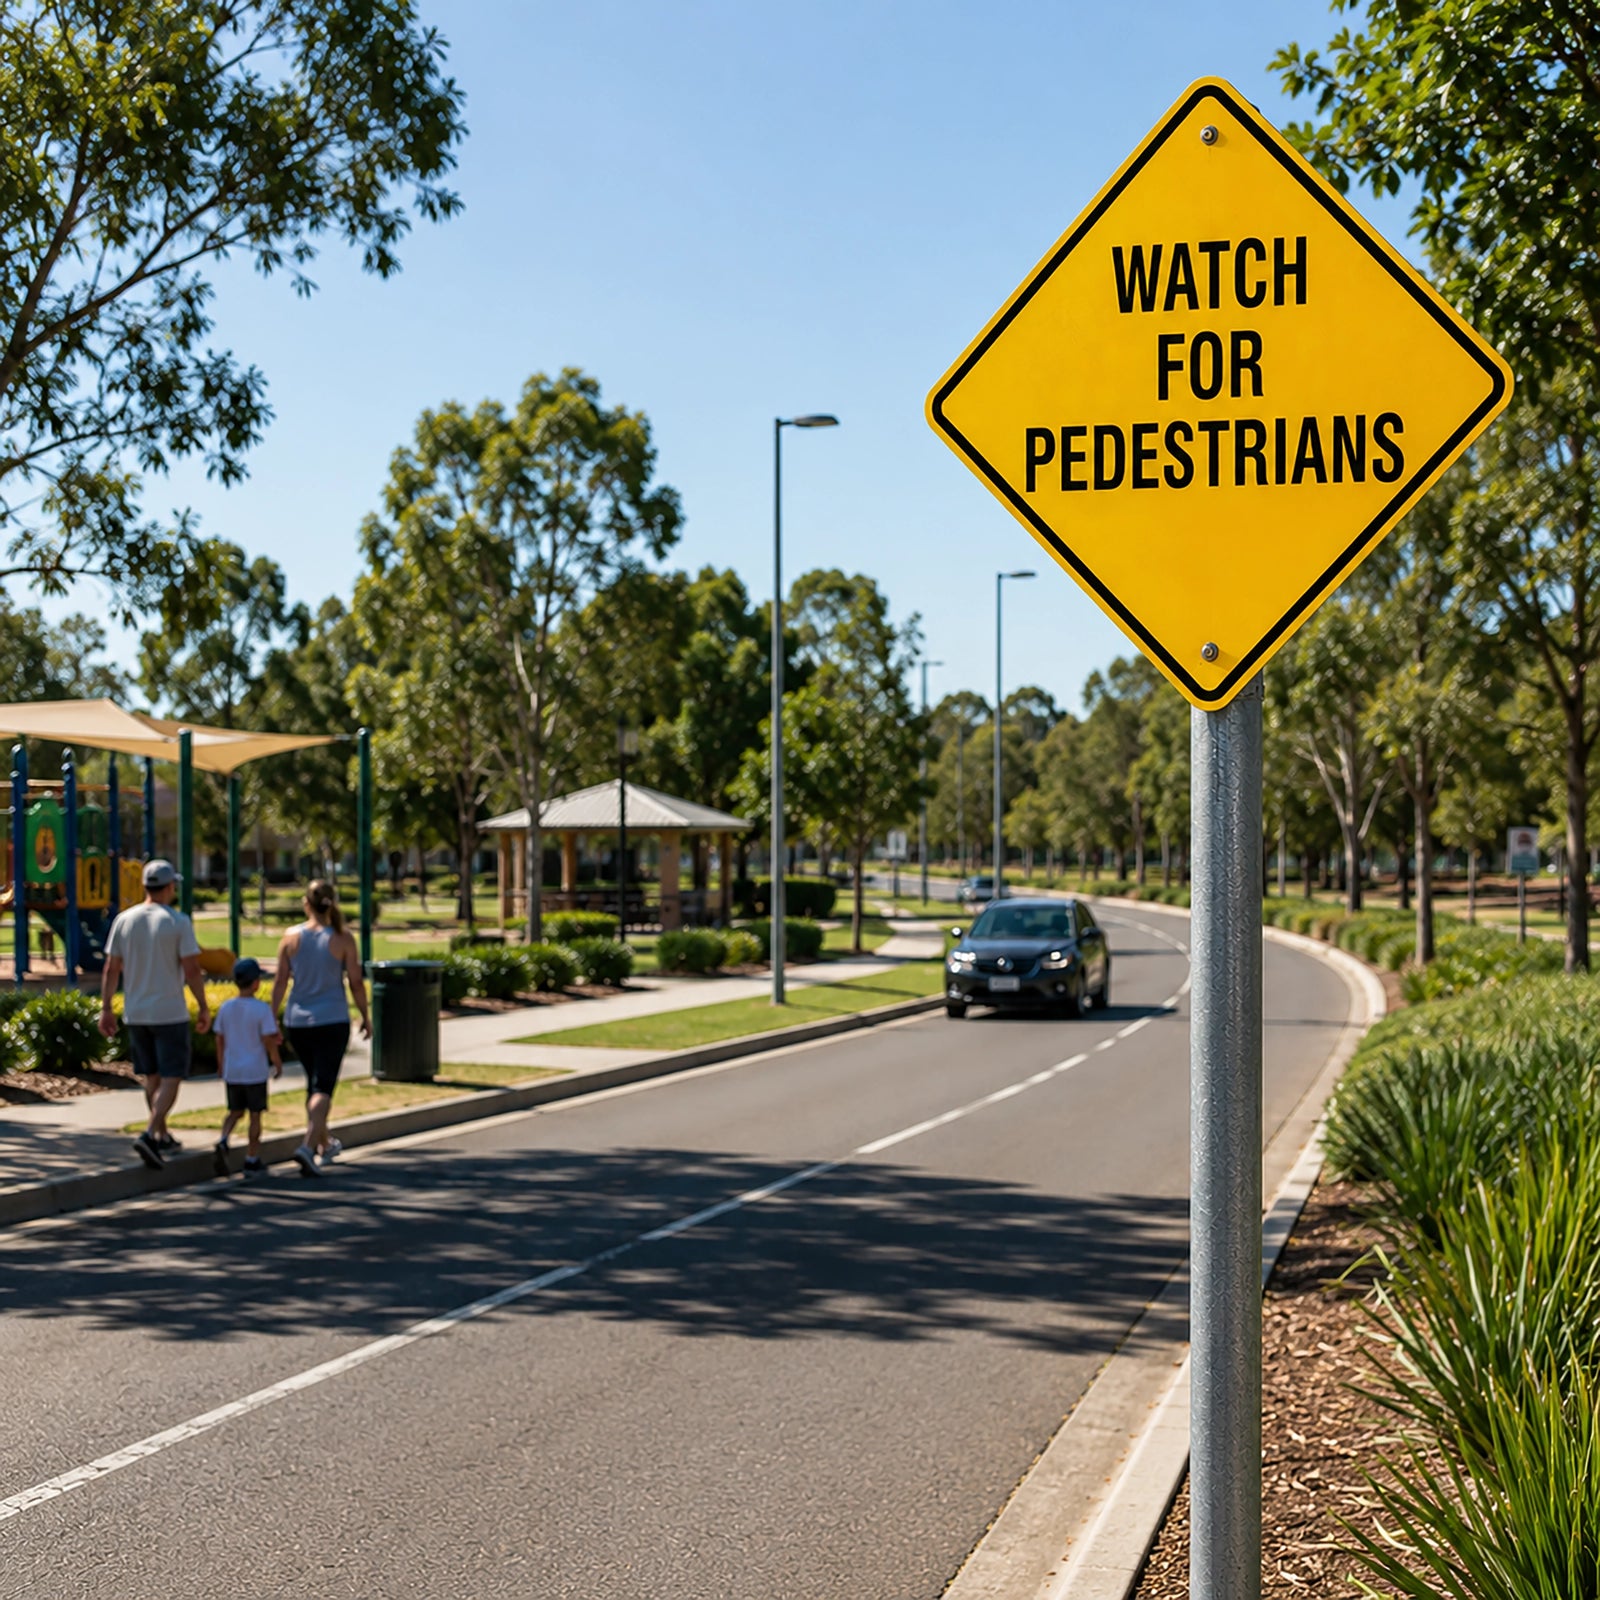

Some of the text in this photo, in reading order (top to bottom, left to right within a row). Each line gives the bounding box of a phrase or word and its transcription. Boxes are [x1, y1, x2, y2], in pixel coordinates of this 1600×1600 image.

[1112, 236, 1307, 314] WATCH
[1157, 331, 1264, 401] FOR
[1025, 412, 1405, 493] PEDESTRIANS
